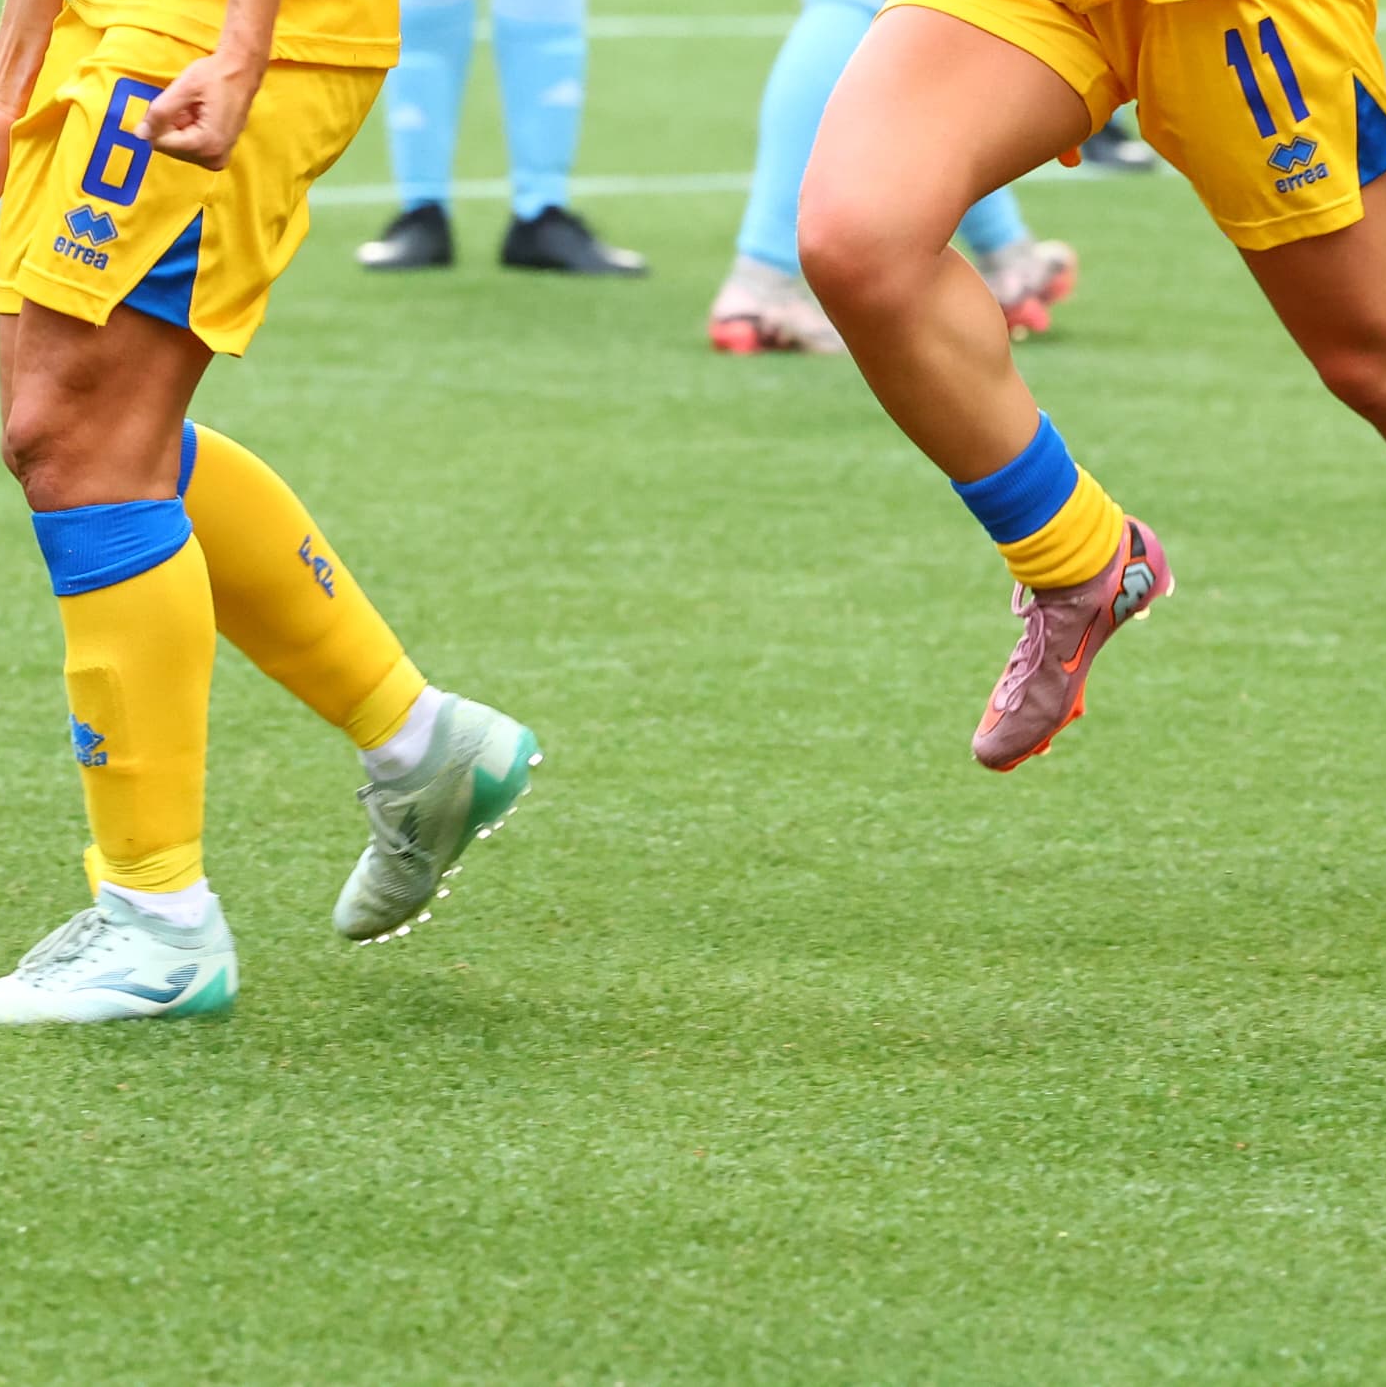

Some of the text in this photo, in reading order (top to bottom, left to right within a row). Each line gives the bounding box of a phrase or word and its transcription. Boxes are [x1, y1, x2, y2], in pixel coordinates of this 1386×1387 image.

[1224, 16, 1311, 139] 11
[81, 76, 166, 207] 6
[1275, 161, 1329, 194] errea
[53, 235, 110, 271] errea
